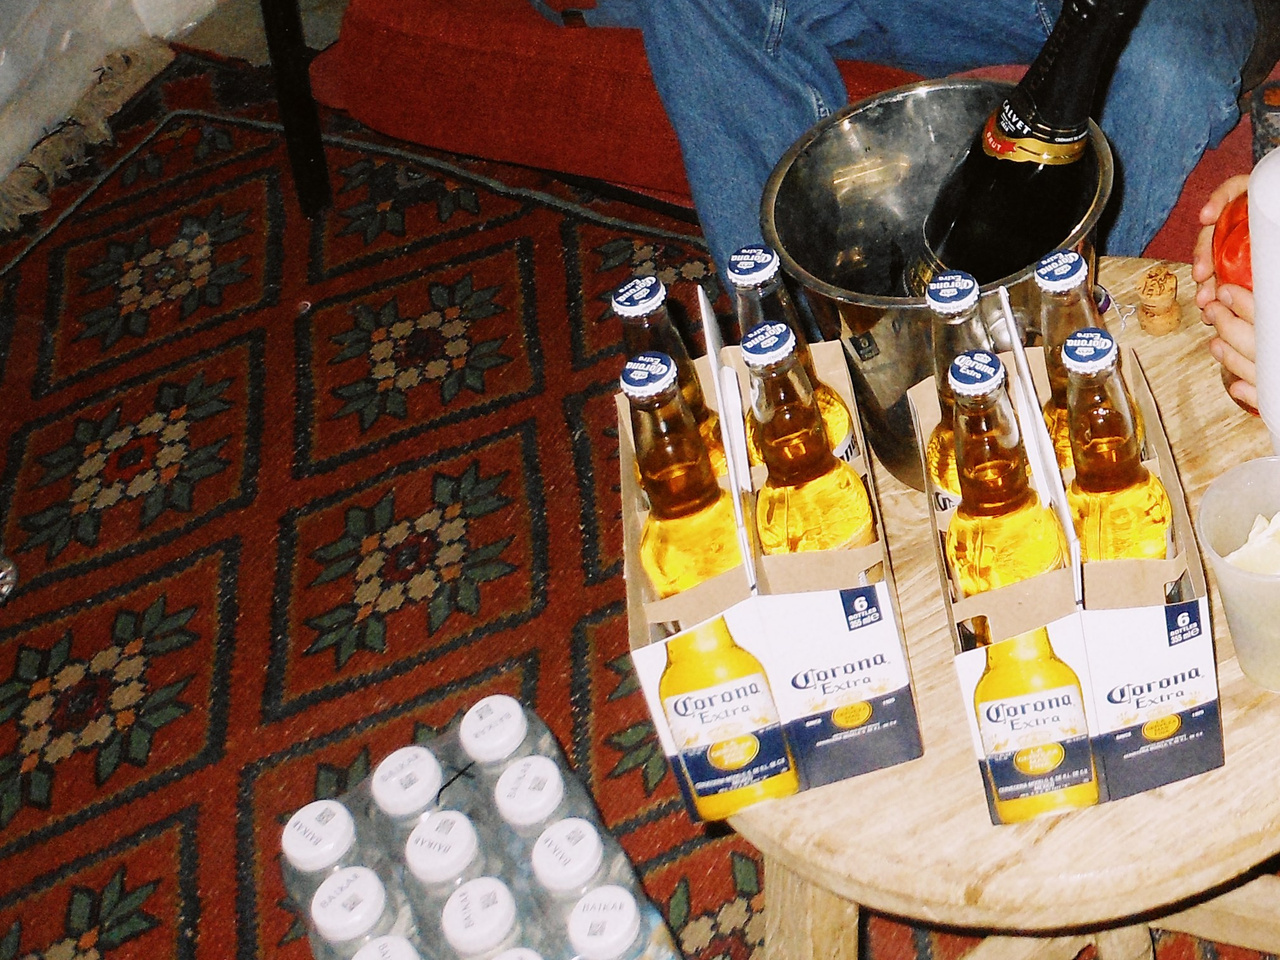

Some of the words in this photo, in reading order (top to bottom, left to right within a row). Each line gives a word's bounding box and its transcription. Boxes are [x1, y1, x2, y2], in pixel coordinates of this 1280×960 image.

[1002, 99, 1031, 134] CALVET
[986, 131, 1001, 151] BRUT
[730, 254, 772, 263] Corona
[1037, 252, 1079, 275] Corona
[1040, 252, 1064, 265] Extra
[615, 276, 657, 302] Corona
[618, 278, 642, 293] Extra
[929, 279, 974, 290] Corona
[743, 323, 787, 349] Corona
[747, 324, 772, 338] Extra
[1076, 332, 1101, 340] Extra
[1066, 338, 1112, 350] Corona
[625, 361, 668, 375] Corona
[638, 355, 661, 364] Extra
[954, 355, 996, 377] Corona
[959, 365, 982, 379] Extra
[853, 596, 868, 612] 6
[1177, 612, 1190, 627] 6
[790, 653, 887, 690] Corona
[821, 676, 872, 695] Extra
[1106, 667, 1200, 704] Corona
[673, 682, 760, 718] Corona
[1136, 690, 1184, 709] Extra
[699, 704, 750, 725] Extra
[986, 694, 1072, 724] Corona
[1010, 715, 1060, 731] Extra
